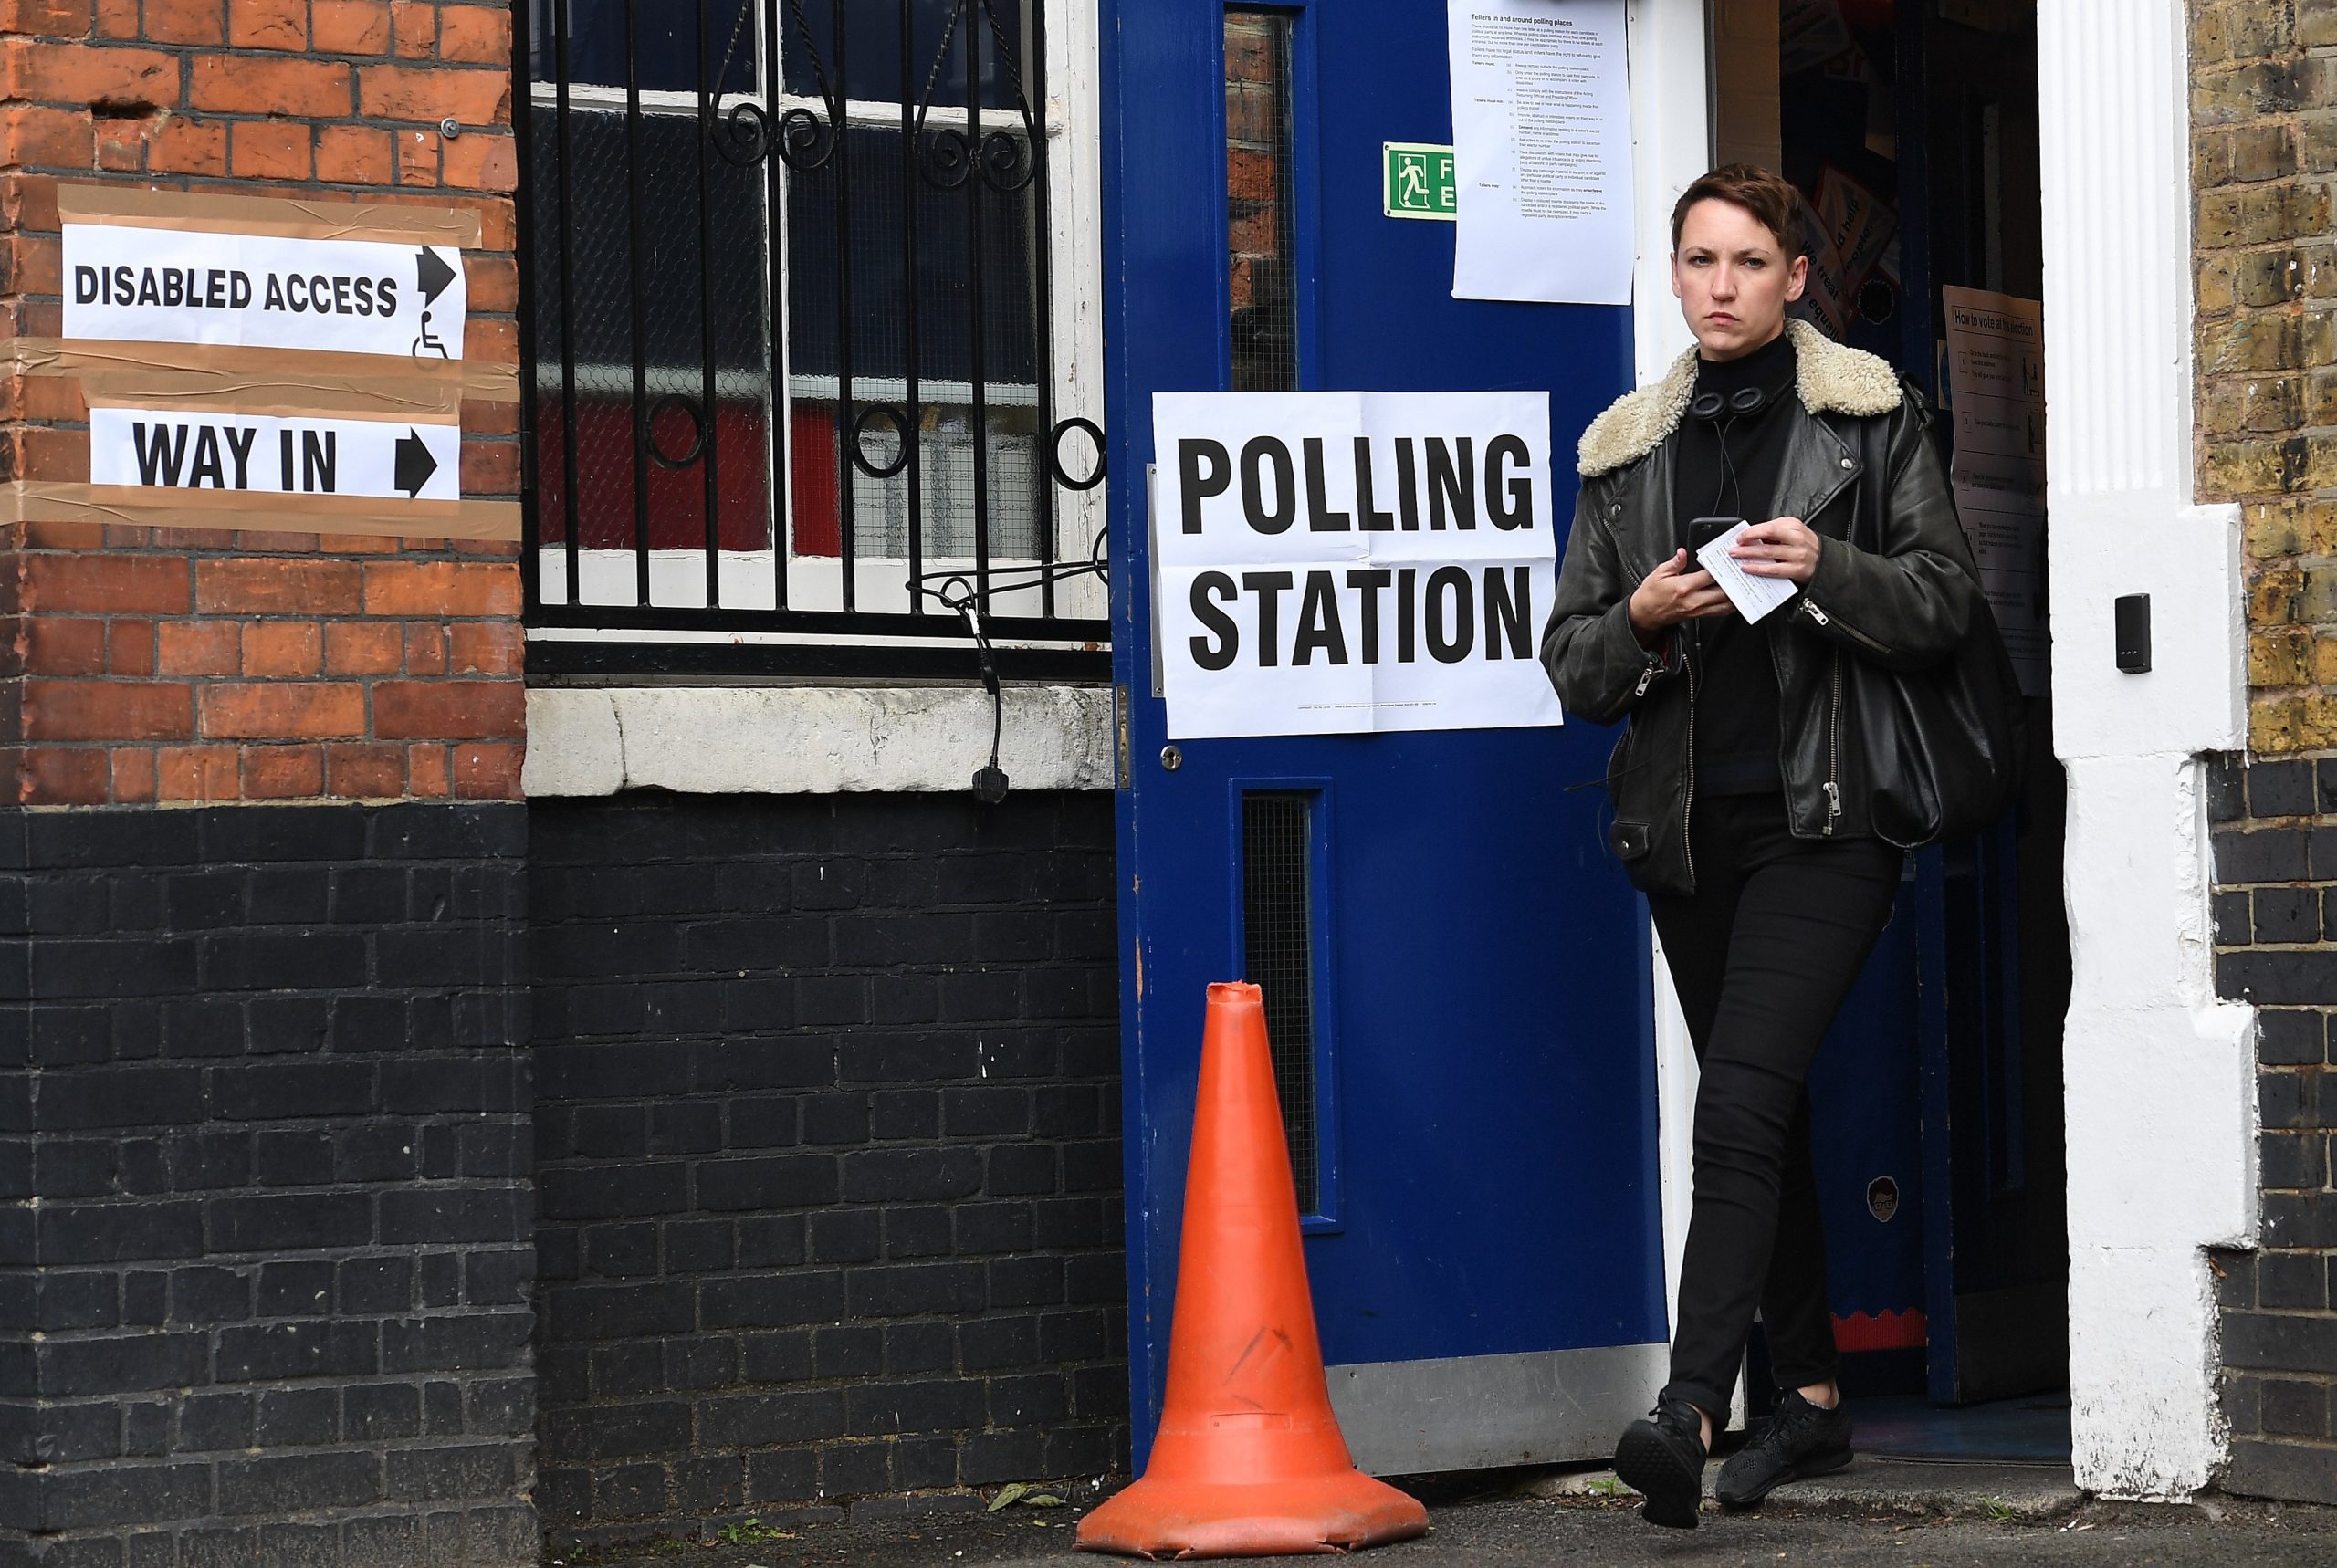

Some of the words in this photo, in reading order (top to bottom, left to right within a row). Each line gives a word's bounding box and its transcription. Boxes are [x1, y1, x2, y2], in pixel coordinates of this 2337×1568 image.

[1471, 13, 1492, 22] Tellers
[1534, 17, 1554, 26] polling
[1554, 18, 1573, 26] places
[75, 265, 252, 310] DISABLED
[263, 272, 397, 318] ACCESS
[1818, 266, 1839, 301] treat
[1954, 308, 1971, 326] How
[1971, 313, 1978, 327] to
[1978, 315, 1995, 329] vote
[132, 422, 257, 490] WAY
[280, 429, 336, 493] IN
[1178, 434, 1534, 535] POLLING
[1189, 565, 1533, 671] STATION
